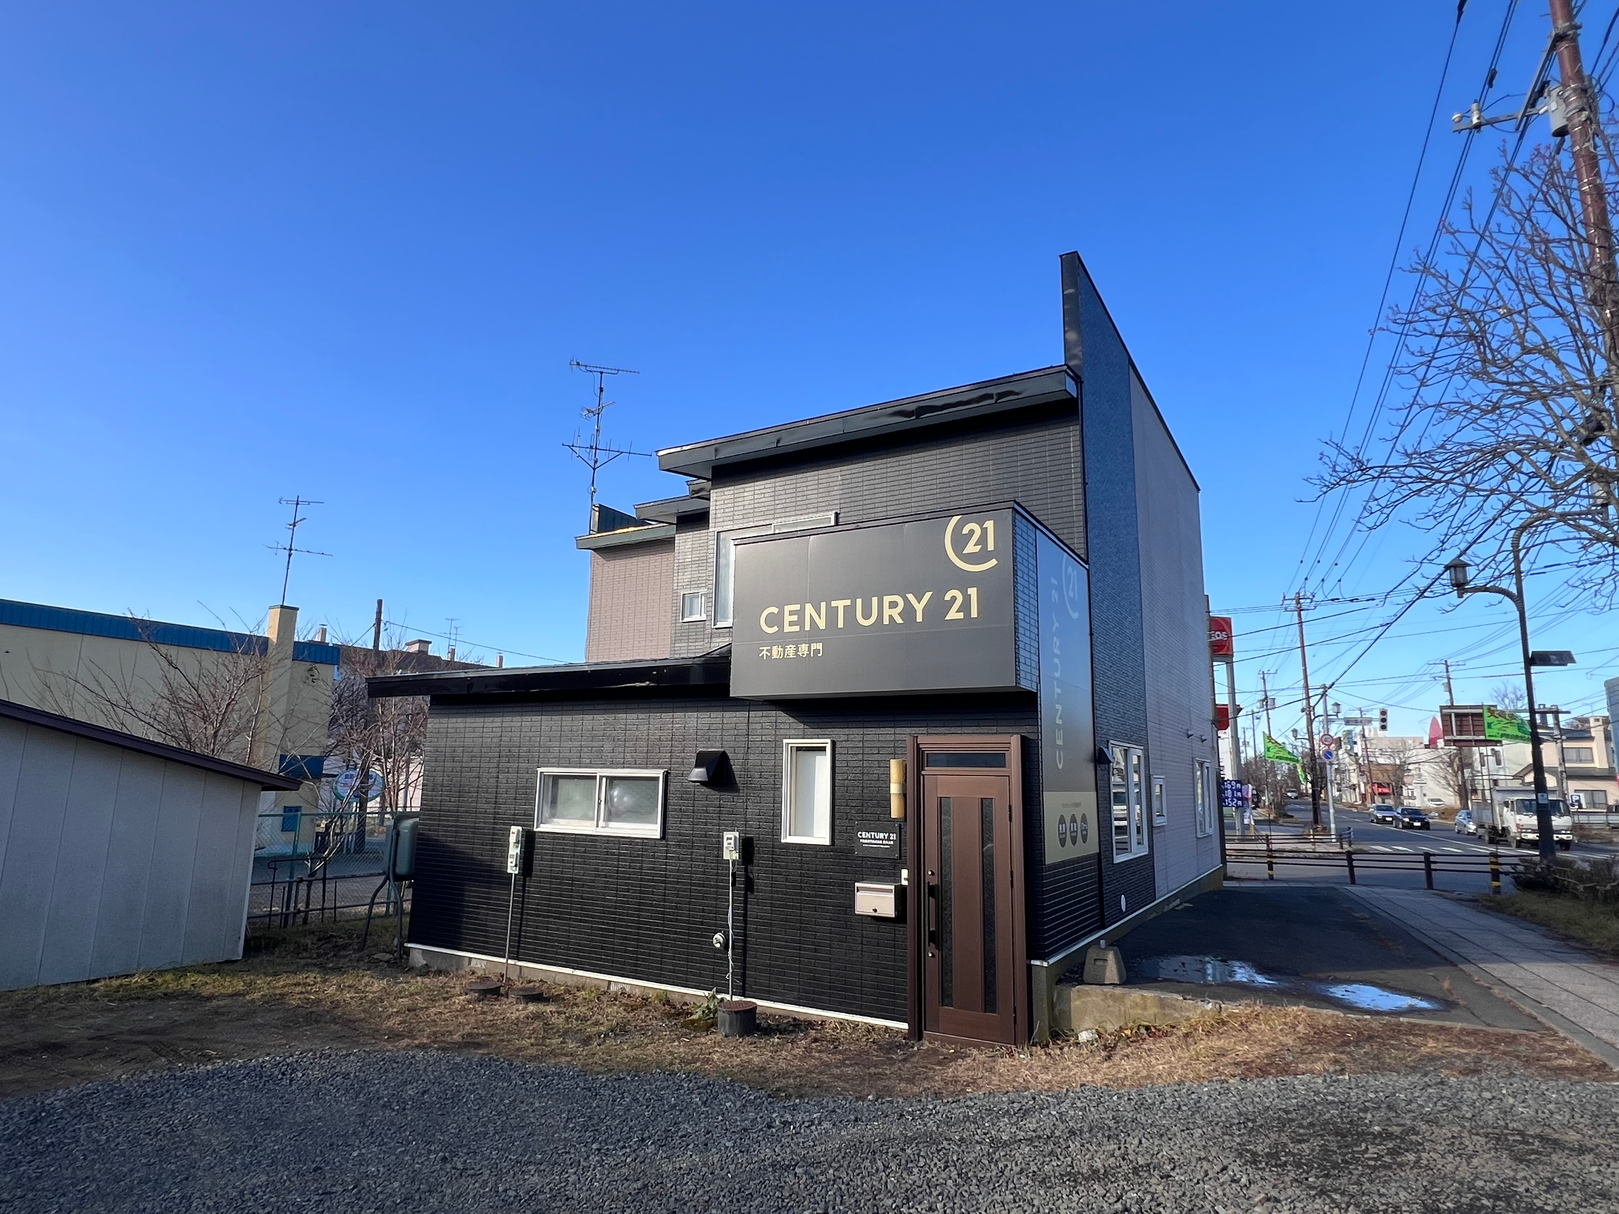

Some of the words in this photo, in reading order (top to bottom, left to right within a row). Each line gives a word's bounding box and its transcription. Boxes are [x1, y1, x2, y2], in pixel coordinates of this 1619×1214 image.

[1051, 577, 1059, 603] 21
[759, 591, 934, 634] CENTURY
[944, 587, 978, 620] 21
[1208, 631, 1228, 641] EOS
[758, 642, 823, 660] 不動産専門
[1052, 612, 1065, 770] CENTURY
[857, 831, 889, 840] CENTURY
